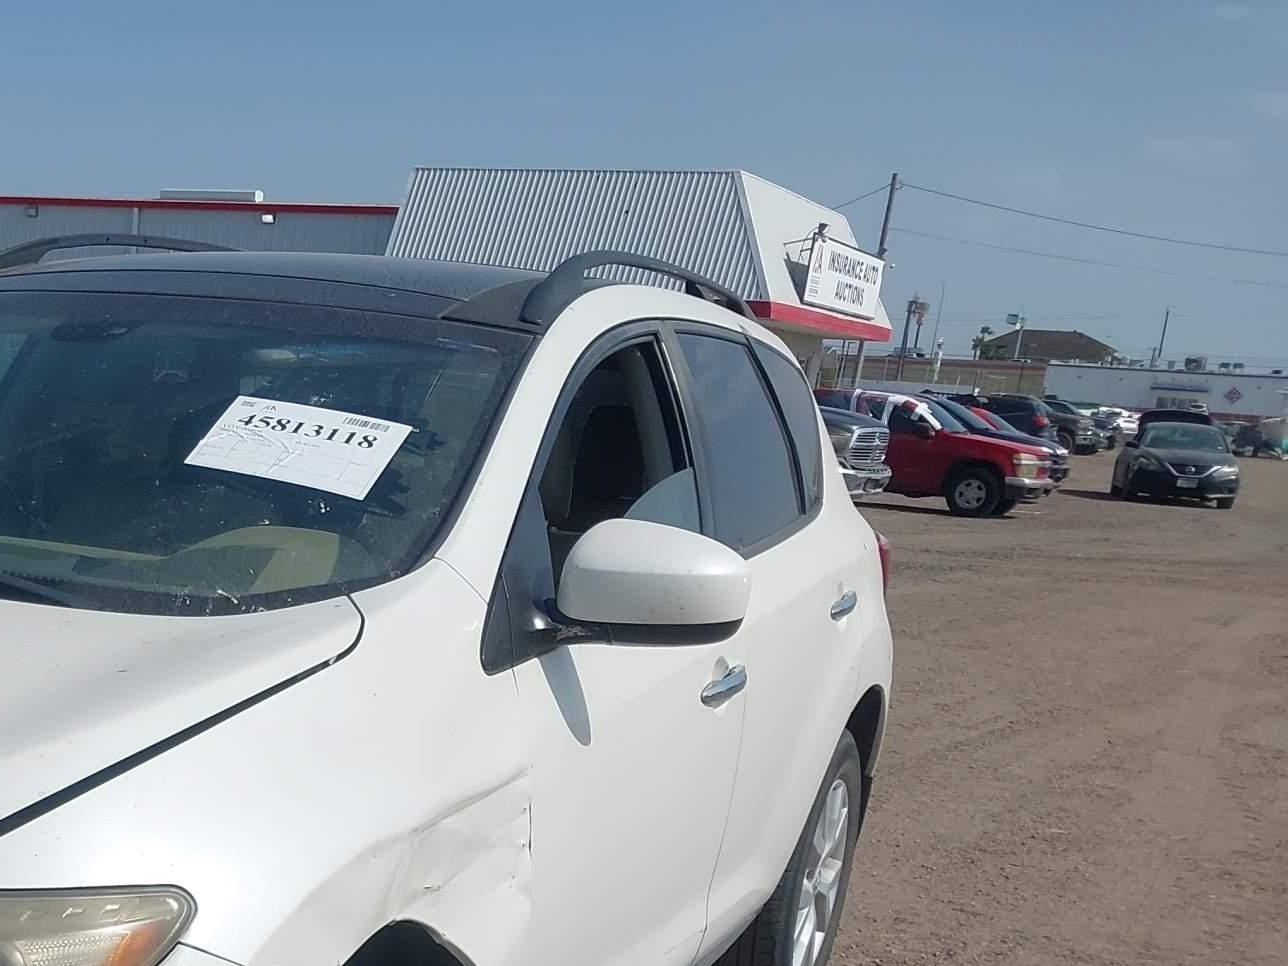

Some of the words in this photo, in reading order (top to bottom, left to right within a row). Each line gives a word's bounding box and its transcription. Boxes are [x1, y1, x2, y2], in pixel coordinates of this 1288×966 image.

[828, 250, 864, 280] INSURANCE
[863, 263, 879, 285] AUTO
[835, 280, 864, 307] AUCTIONS
[237, 414, 379, 449] 45813118
